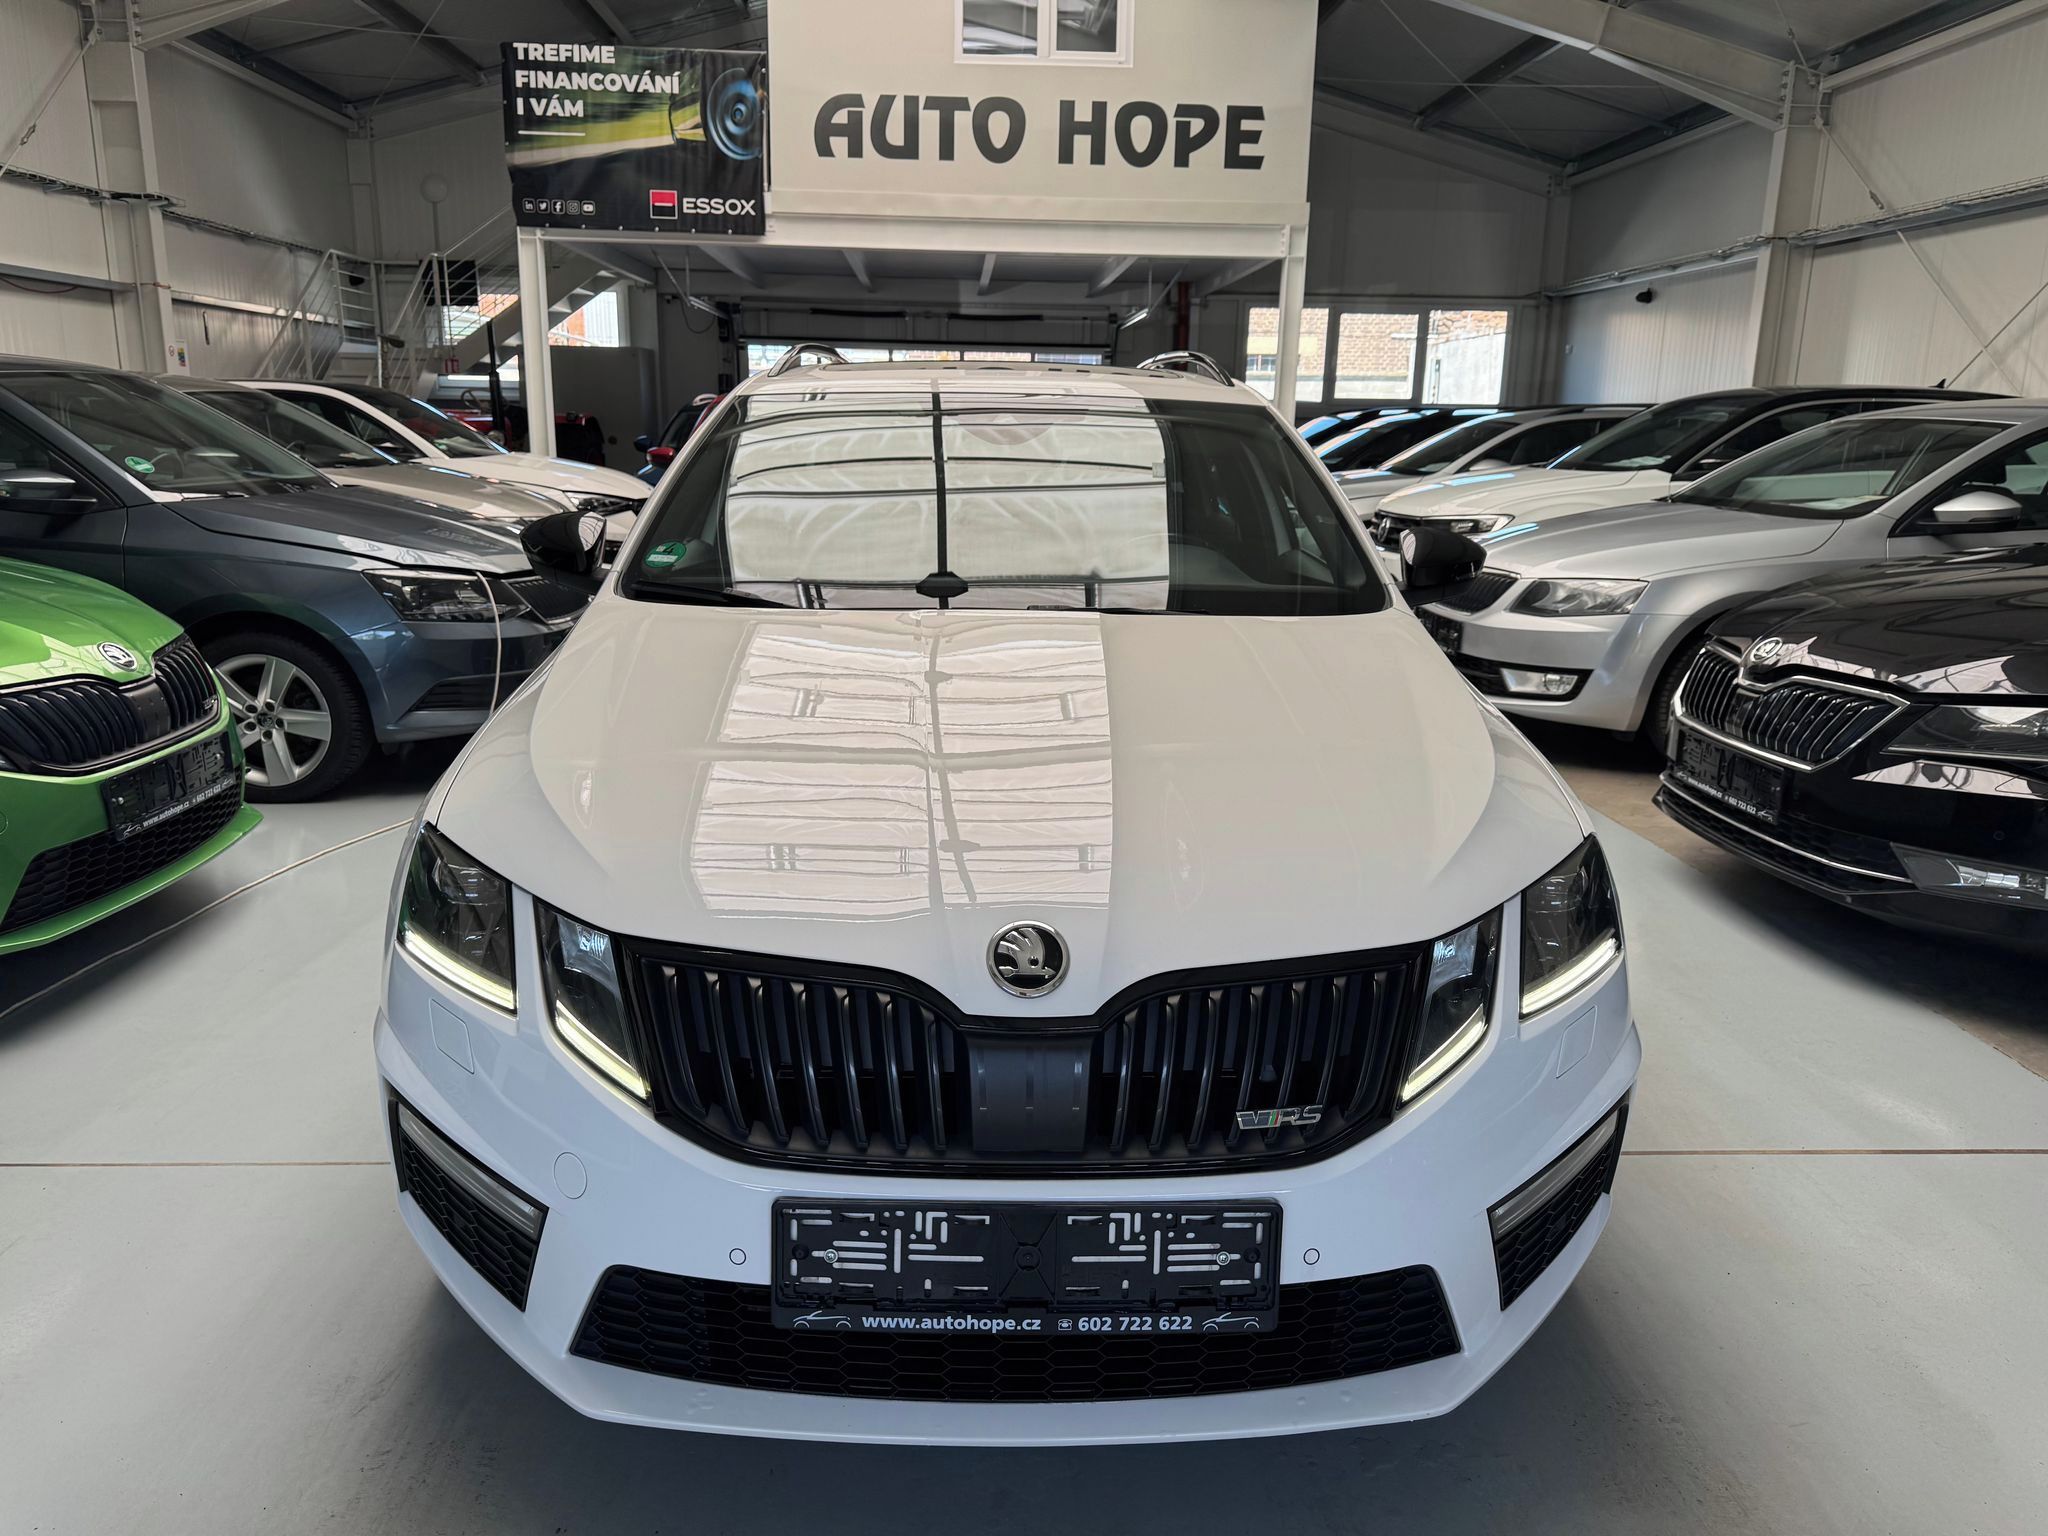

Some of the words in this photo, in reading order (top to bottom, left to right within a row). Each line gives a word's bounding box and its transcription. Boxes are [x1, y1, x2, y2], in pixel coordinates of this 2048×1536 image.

[513, 42, 616, 64] TREFIME
[515, 70, 680, 94] FINANCOVÁNÍ
[516, 97, 524, 115] I
[529, 94, 584, 117] VÁM
[814, 93, 1026, 164] AUTO
[1058, 99, 1266, 170] HOPE
[682, 197, 756, 216] ESSOX
[862, 1314, 1042, 1334] www.autohope.cz
[1077, 1316, 1112, 1332] 602
[1119, 1316, 1153, 1332] 722
[1159, 1316, 1193, 1331] 622
